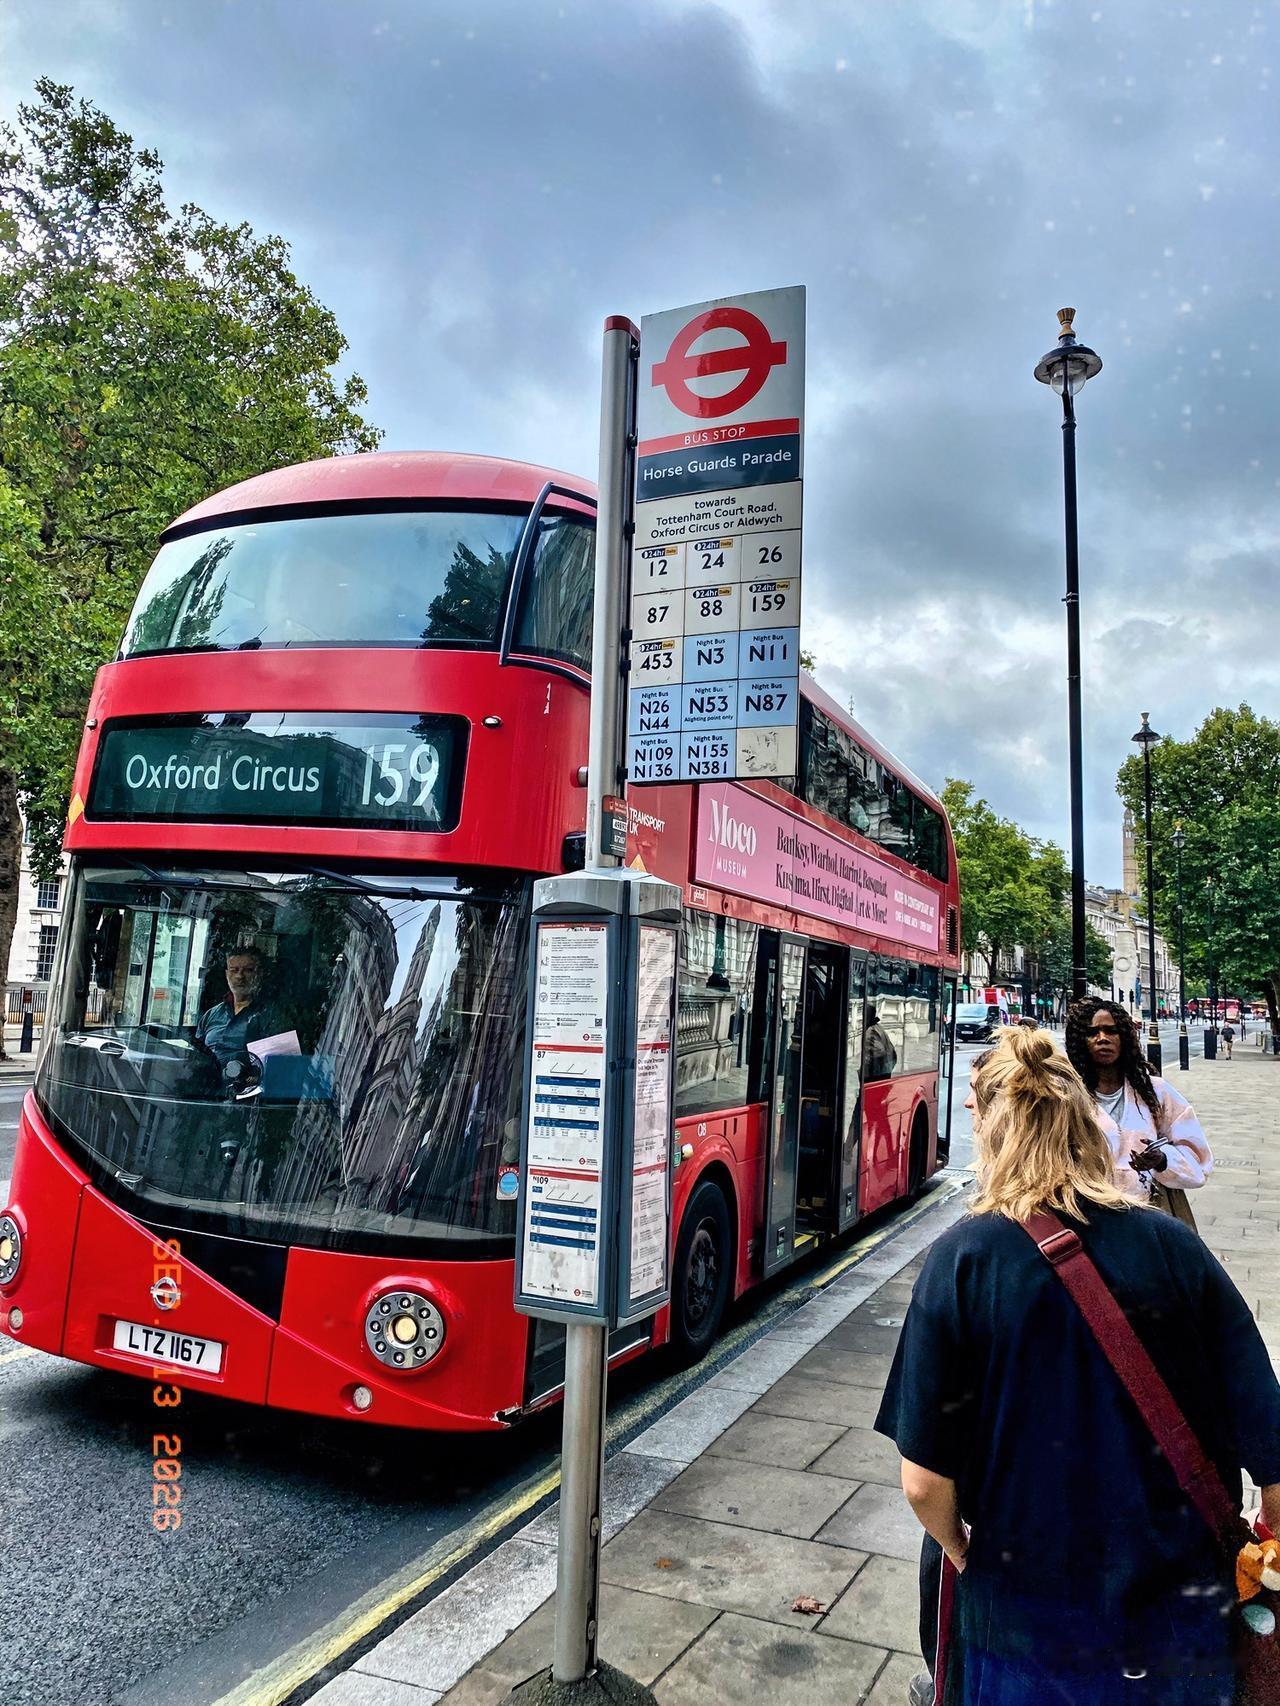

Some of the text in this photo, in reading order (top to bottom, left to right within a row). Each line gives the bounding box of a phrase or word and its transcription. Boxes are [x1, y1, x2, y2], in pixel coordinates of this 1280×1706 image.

[684, 426, 746, 445] BUS STOP
[644, 450, 792, 481] Horse Guards Parade
[694, 496, 736, 509] towards
[656, 511, 711, 527] Tottenham
[714, 506, 745, 518] Court
[650, 513, 783, 539] Oxford Circus or Aldwych
[648, 548, 666, 558] 24hr
[701, 541, 720, 550] 24hr
[701, 552, 725, 570] 24
[758, 546, 783, 564] 26
[649, 559, 668, 577] 12
[699, 589, 718, 598] 24hr
[756, 583, 776, 592] 24hr
[700, 599, 723, 618] 88
[752, 593, 786, 612] 159
[647, 605, 669, 624] 87
[696, 639, 713, 647] Night
[753, 634, 770, 642] Night
[640, 652, 673, 671] 453
[697, 647, 725, 666] N3
[750, 643, 787, 662] N11
[695, 687, 711, 695] Night
[751, 683, 769, 691] Night
[640, 700, 670, 715] N26
[689, 695, 729, 714] N53
[745, 693, 788, 712] N87
[639, 716, 670, 732] N44
[634, 746, 673, 763] N109
[687, 743, 729, 759] N155
[125, 743, 439, 807] Oxford Circus 159
[634, 763, 673, 778] N136
[688, 761, 727, 775] N381
[629, 807, 665, 833] TRANSPORT
[629, 820, 639, 837] UK
[708, 799, 757, 857] Moco
[776, 826, 810, 868] Banksy,
[810, 842, 838, 878] Warhol,
[716, 855, 747, 878] MUSEUM
[533, 1176, 549, 1185] N109
[128, 1326, 206, 1365] LTZ 1167
